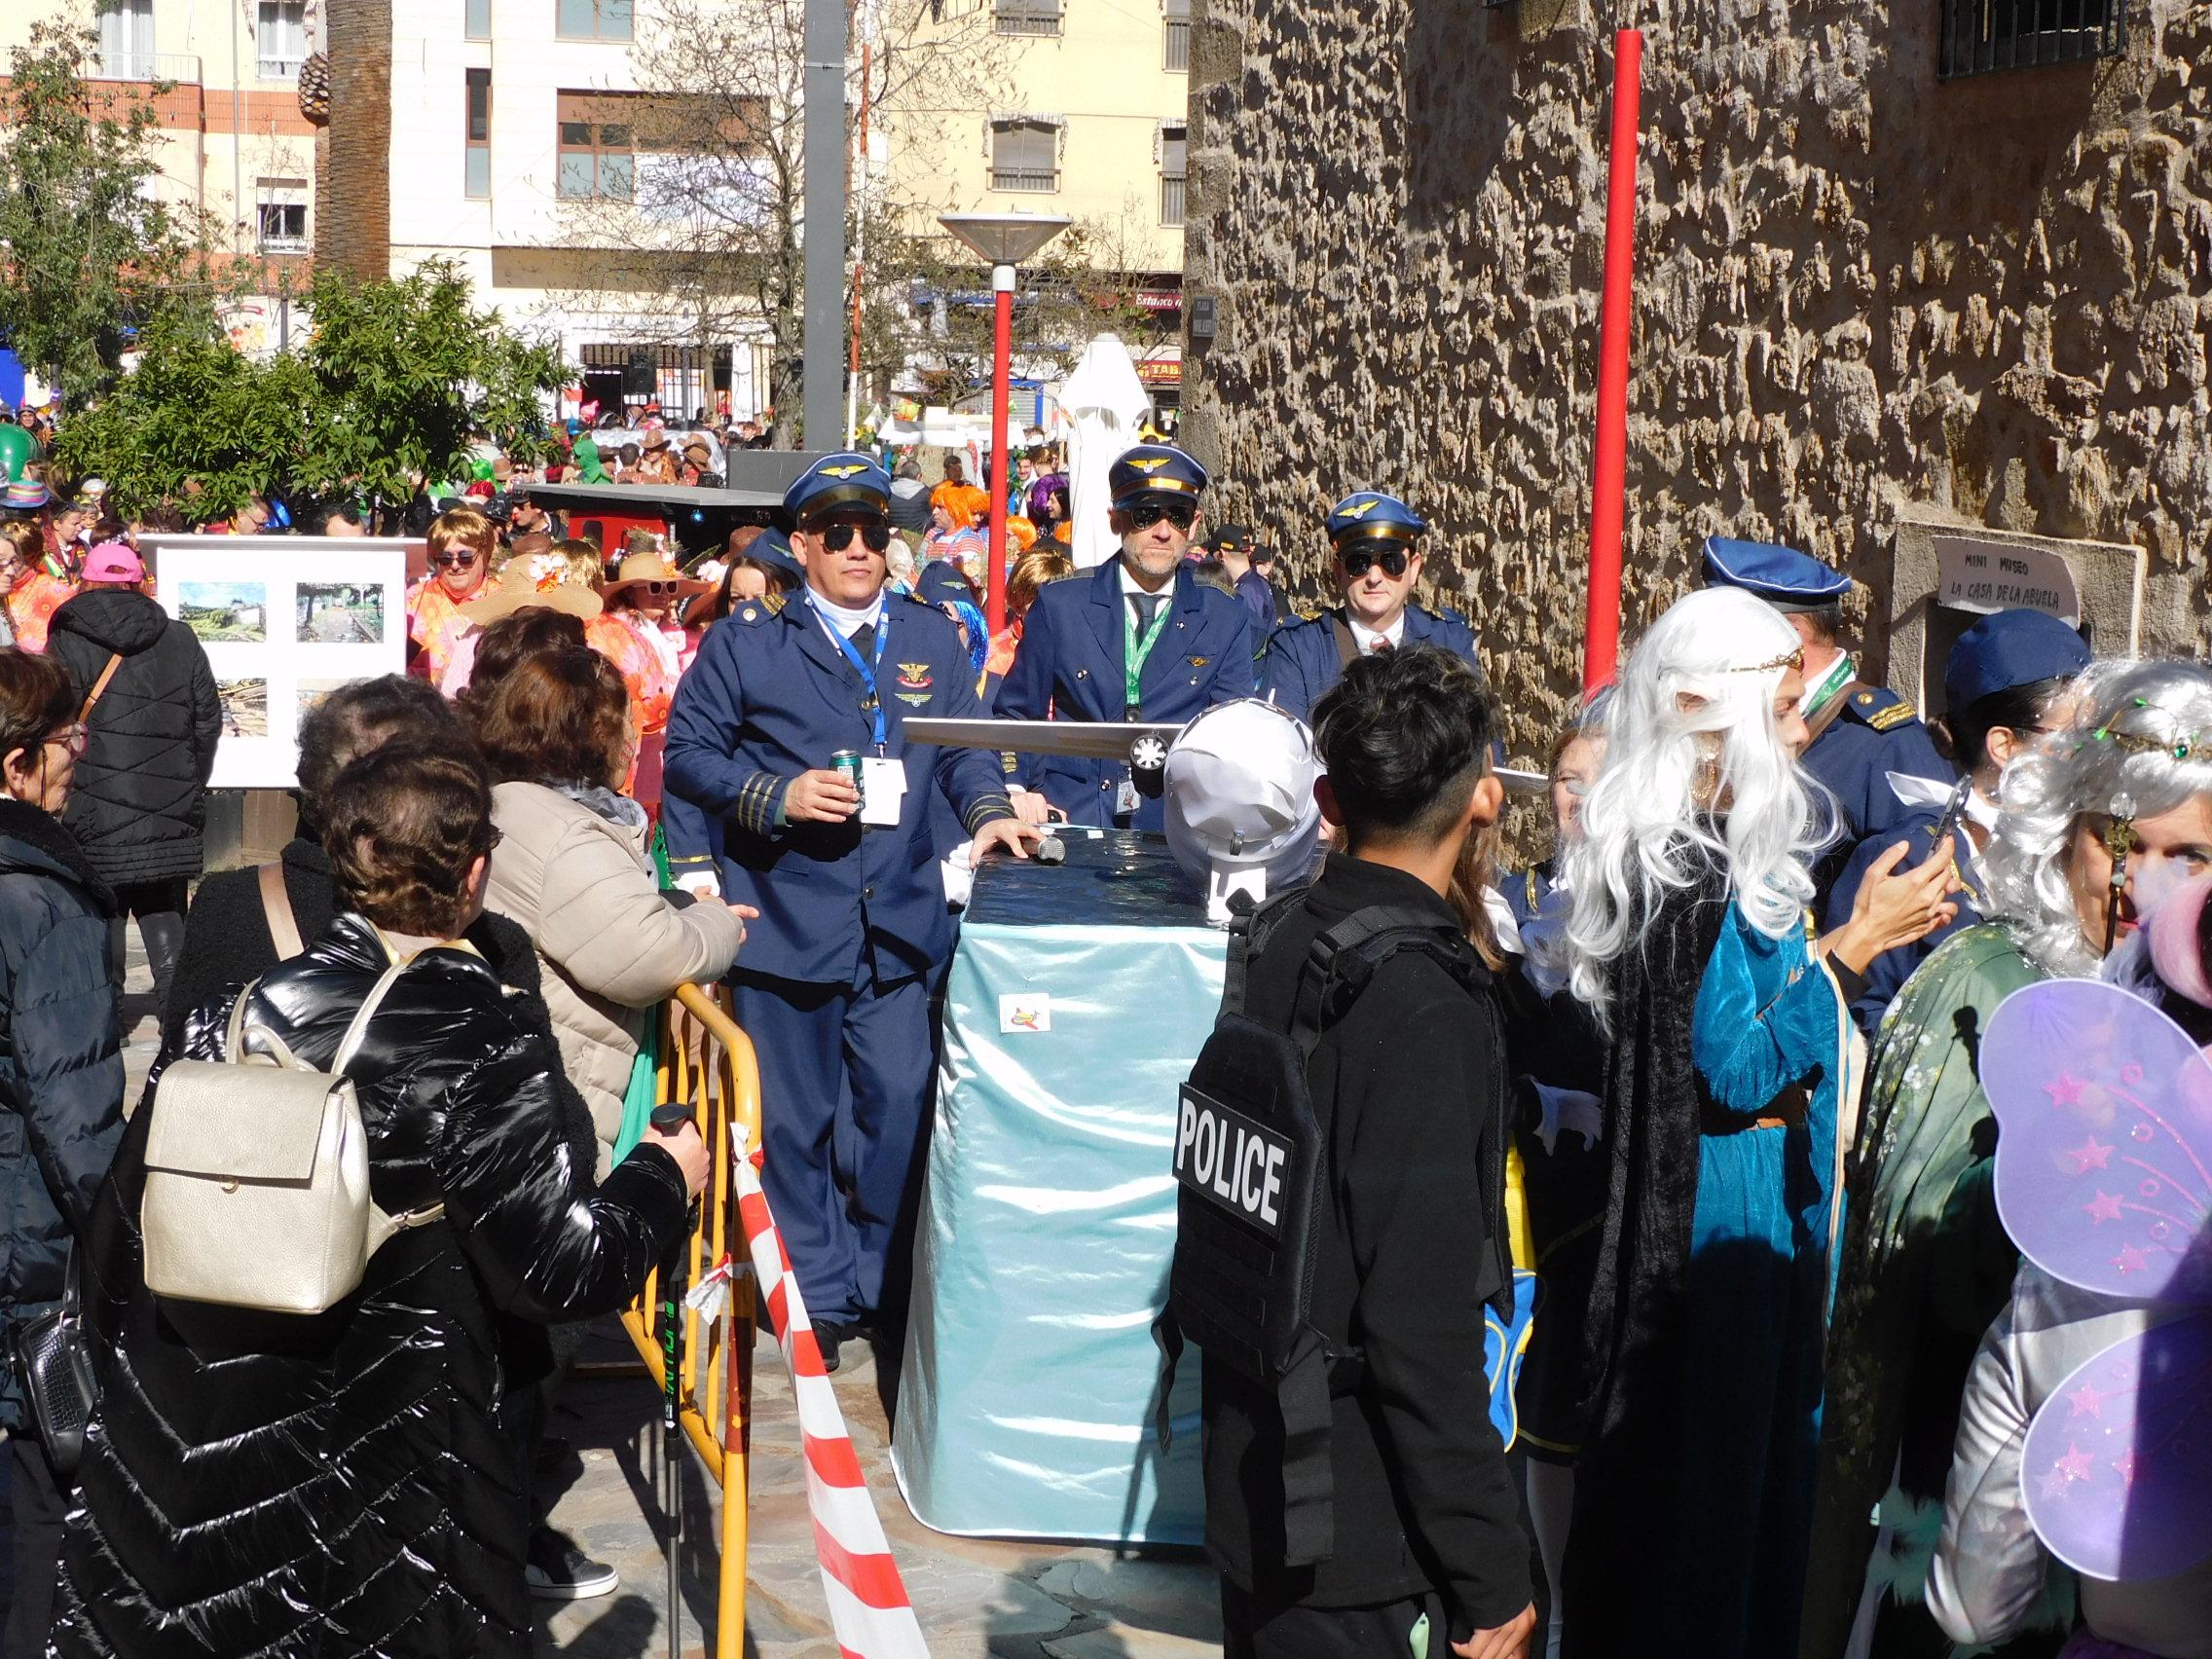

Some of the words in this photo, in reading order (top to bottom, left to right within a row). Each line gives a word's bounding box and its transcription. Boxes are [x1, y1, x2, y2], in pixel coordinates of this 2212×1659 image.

[1135, 293, 1173, 307] Estanco
[1151, 364, 1181, 375] TAB
[1965, 554, 1987, 568] MINI
[2000, 557, 2028, 575] MUSEO
[1951, 580, 1962, 597] LA
[1968, 583, 1992, 601] CASA
[1996, 584, 2009, 602] DE
[2009, 585, 2020, 604] LA
[2021, 588, 2059, 610] ABUELA
[1176, 1097, 1285, 1226] POLICE
